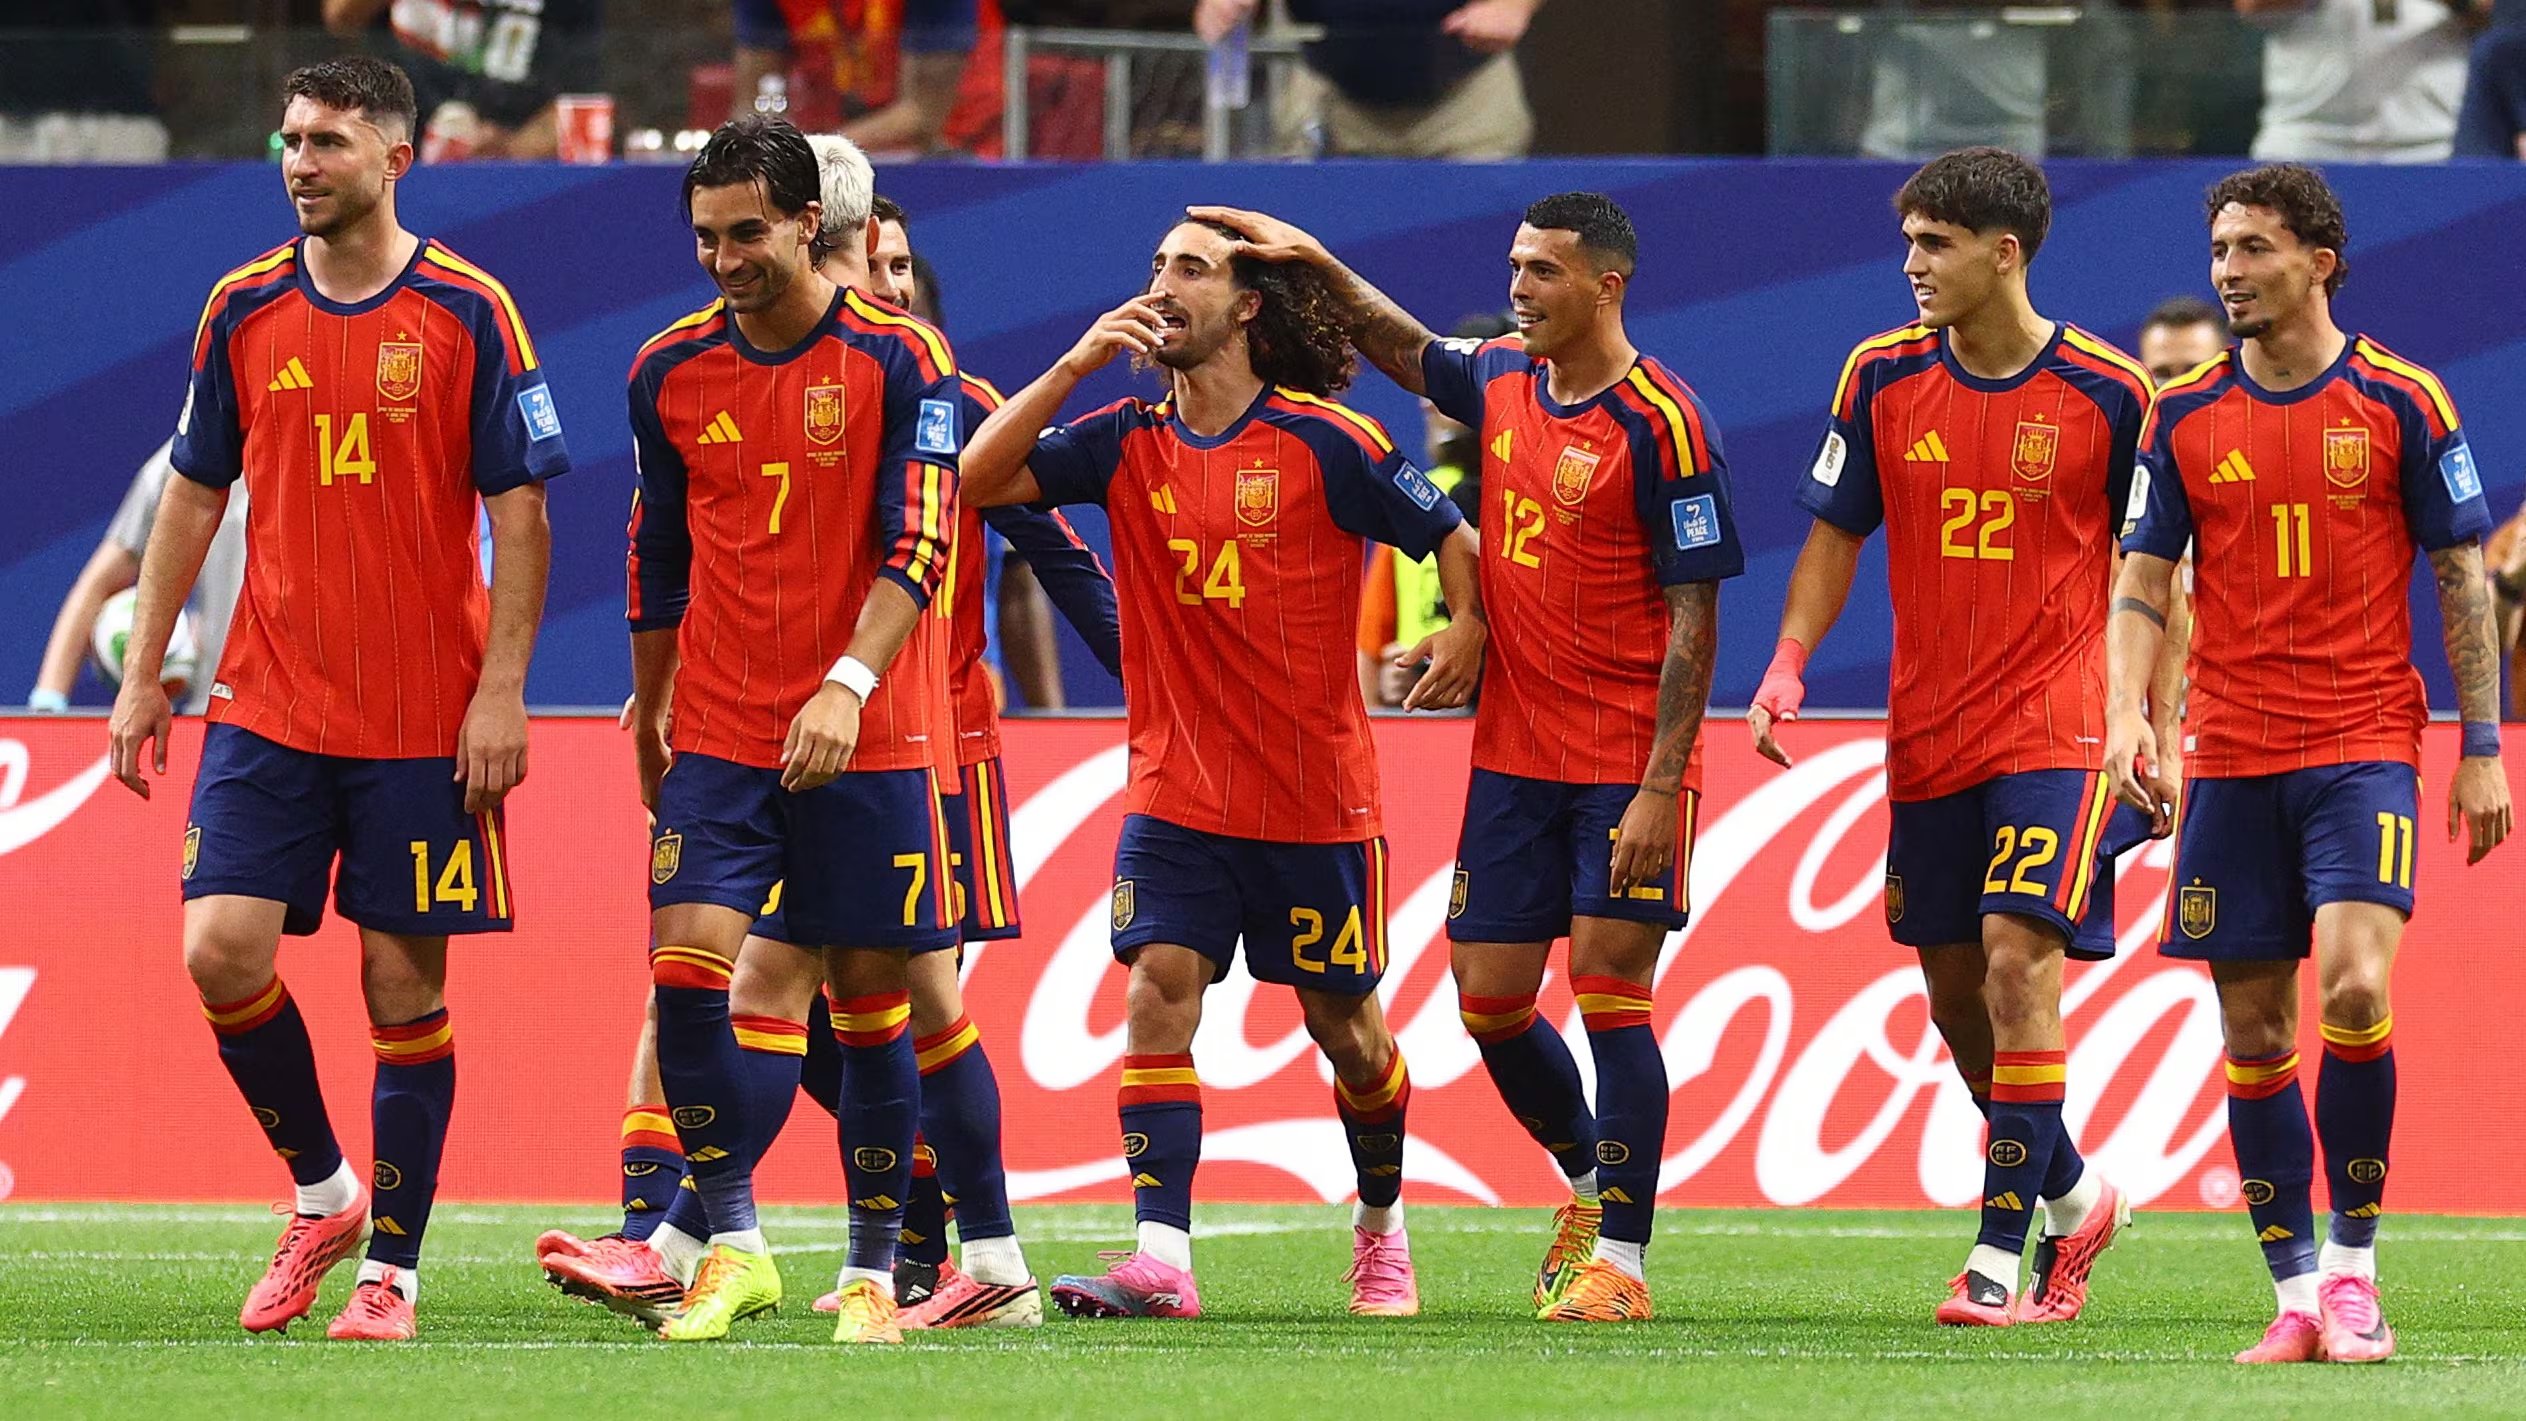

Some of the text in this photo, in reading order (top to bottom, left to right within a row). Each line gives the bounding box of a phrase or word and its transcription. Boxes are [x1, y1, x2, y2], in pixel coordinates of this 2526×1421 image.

[314, 412, 376, 487] 14
[760, 461, 791, 535] 7
[1502, 488, 1546, 569] 12
[1940, 487, 2015, 561] 22
[1168, 537, 1246, 609] 24
[2272, 503, 2312, 578] 11
[409, 839, 479, 914] 14
[1983, 826, 2060, 898] 22
[2376, 811, 2414, 889] 11
[893, 852, 926, 927] 7
[1290, 905, 1369, 976] 24
